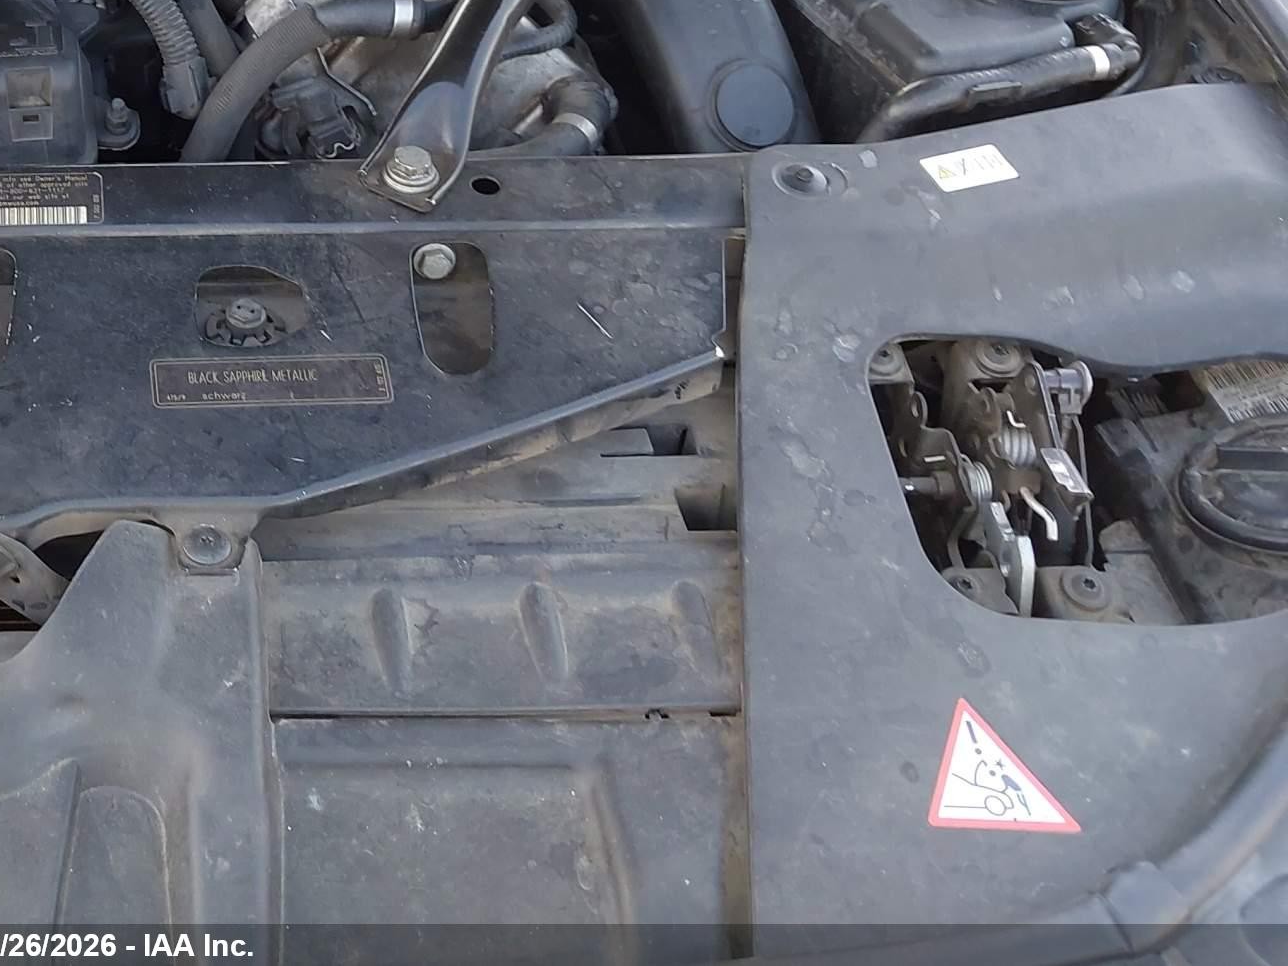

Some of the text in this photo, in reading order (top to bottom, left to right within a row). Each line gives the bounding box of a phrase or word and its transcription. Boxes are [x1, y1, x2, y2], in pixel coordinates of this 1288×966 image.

[187, 368, 319, 384] BLACK SAPPHIRE METALLIC
[202, 390, 247, 401] schwarz
